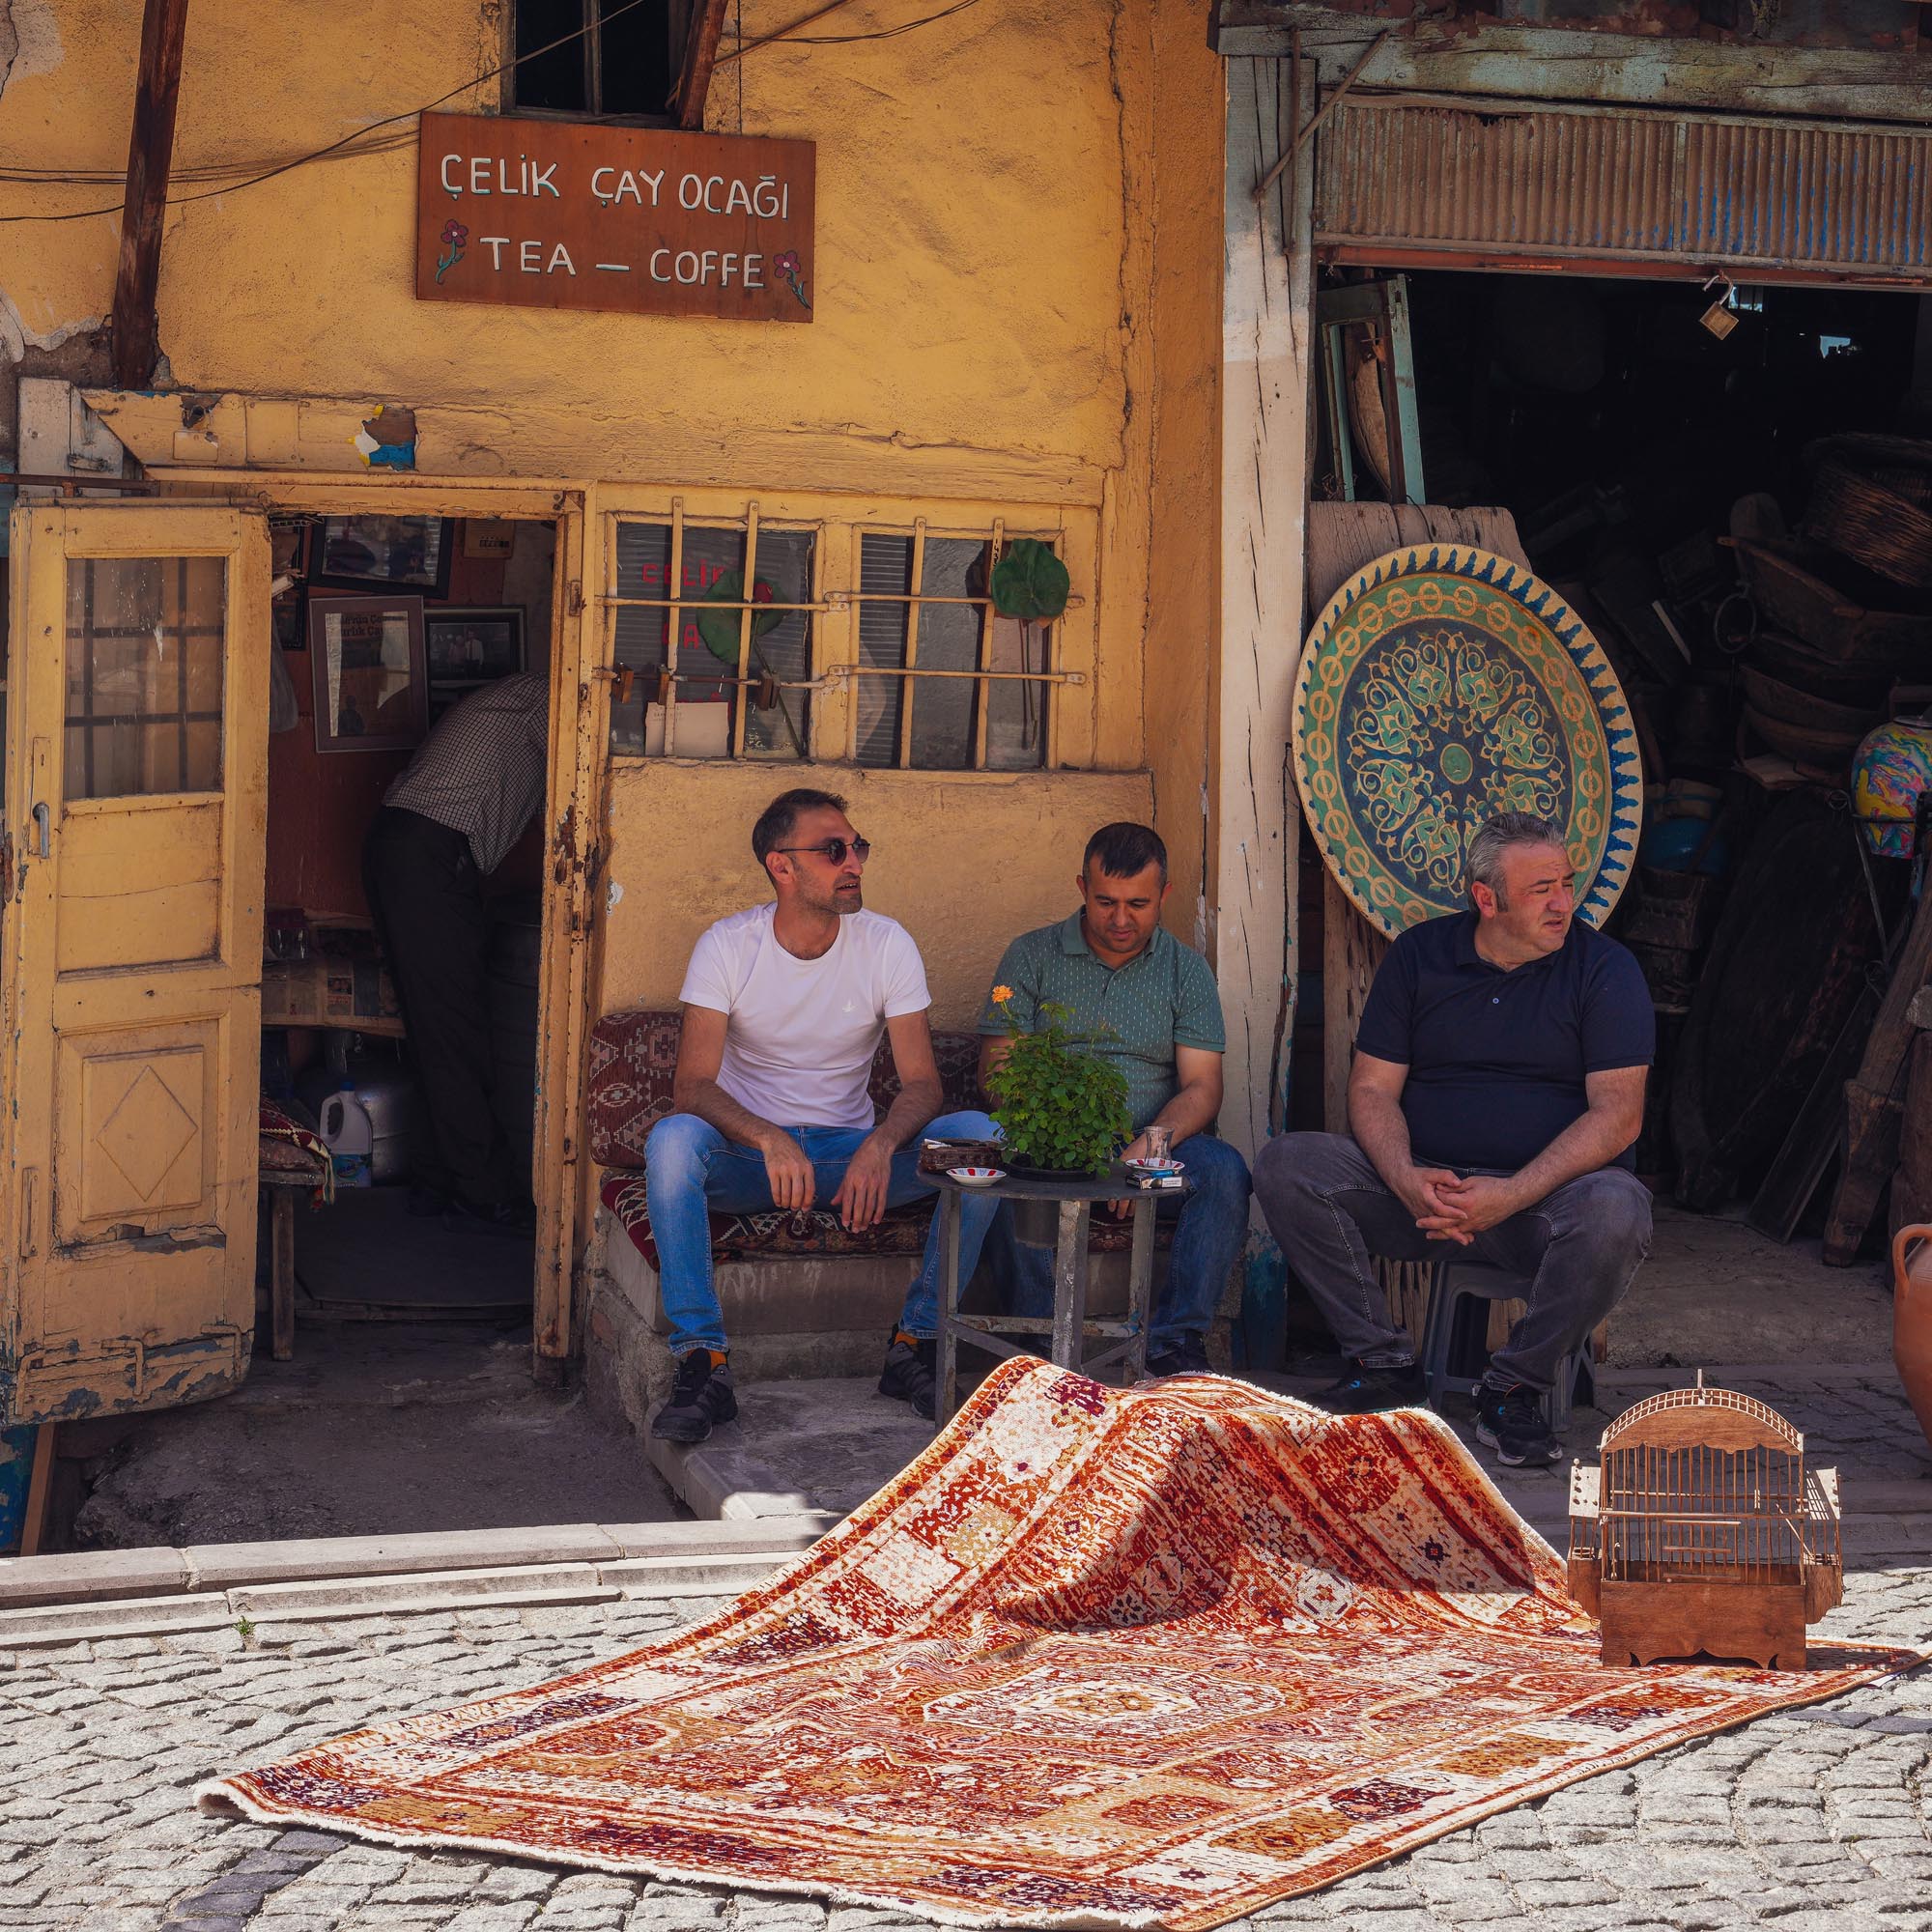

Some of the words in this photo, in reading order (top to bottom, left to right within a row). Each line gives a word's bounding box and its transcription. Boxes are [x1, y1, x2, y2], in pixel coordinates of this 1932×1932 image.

[440, 154, 560, 200] ÇELİK
[591, 167, 665, 206] ÇAY
[678, 173, 789, 219] OCAĞI
[479, 237, 577, 275] TEA
[649, 248, 765, 288] COFFE
